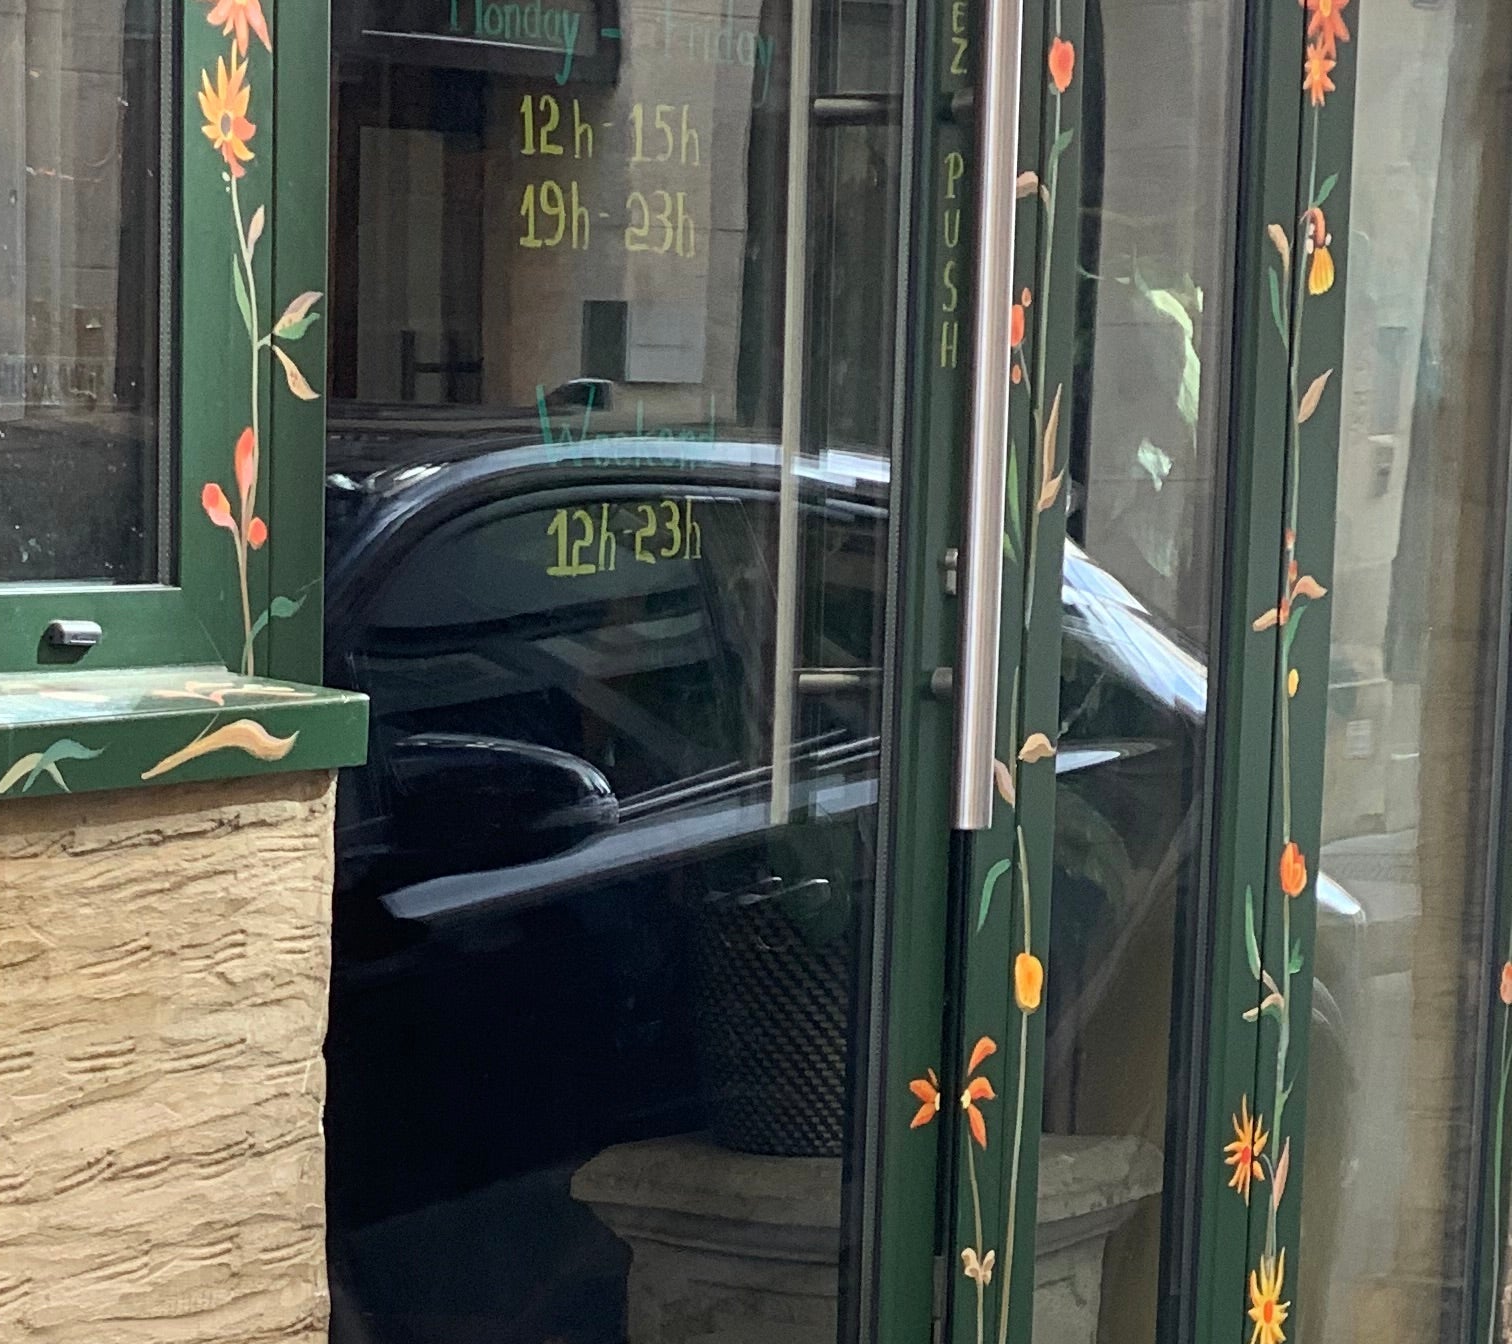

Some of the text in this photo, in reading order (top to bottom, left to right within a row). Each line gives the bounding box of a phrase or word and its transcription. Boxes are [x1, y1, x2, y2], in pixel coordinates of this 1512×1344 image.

[519, 94, 593, 160] 12h
[627, 102, 701, 167] 15h
[519, 179, 591, 250] 19h
[624, 189, 697, 259] 23h
[940, 151, 965, 369] PUSH
